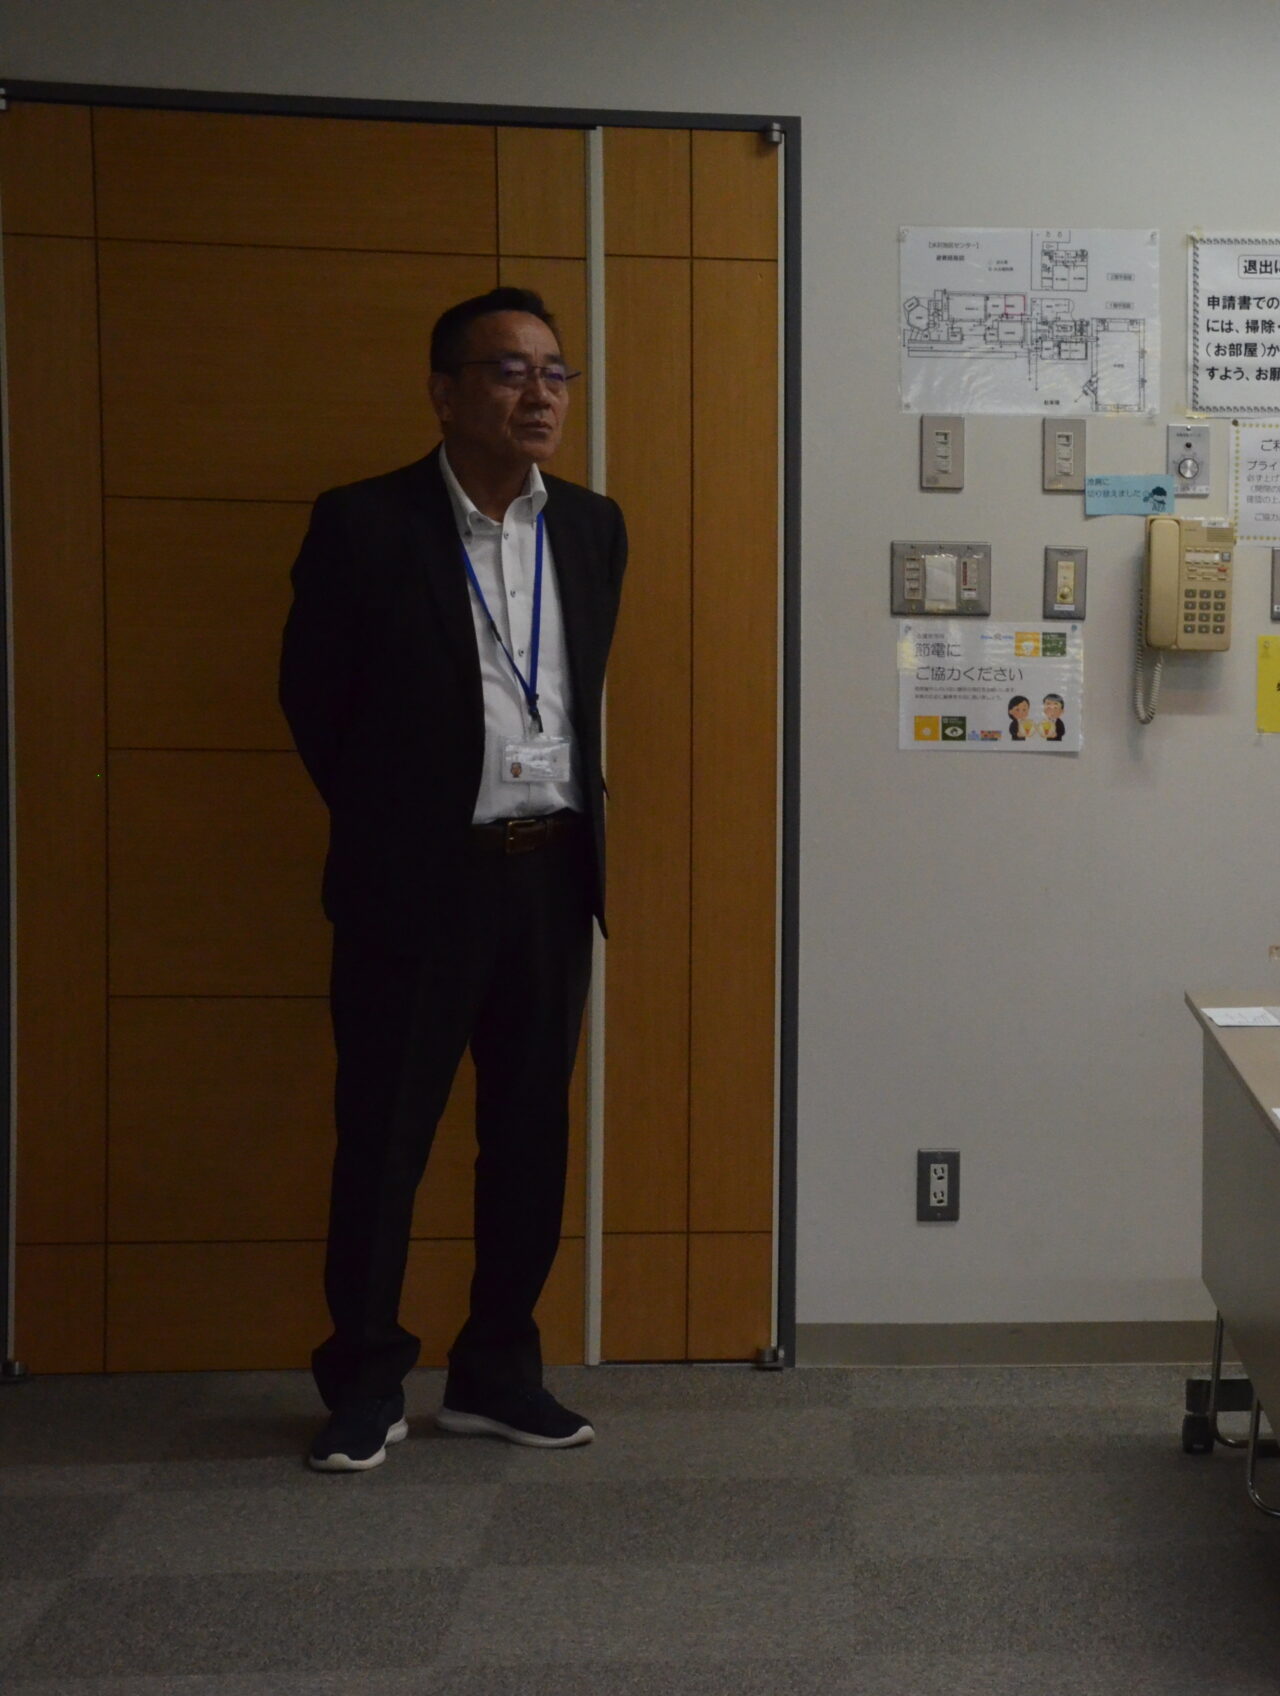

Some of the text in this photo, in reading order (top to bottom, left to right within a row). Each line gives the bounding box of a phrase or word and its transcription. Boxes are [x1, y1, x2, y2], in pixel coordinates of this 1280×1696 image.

[915, 642, 961, 658] 節電に
[916, 666, 1023, 681] ご協力ください
